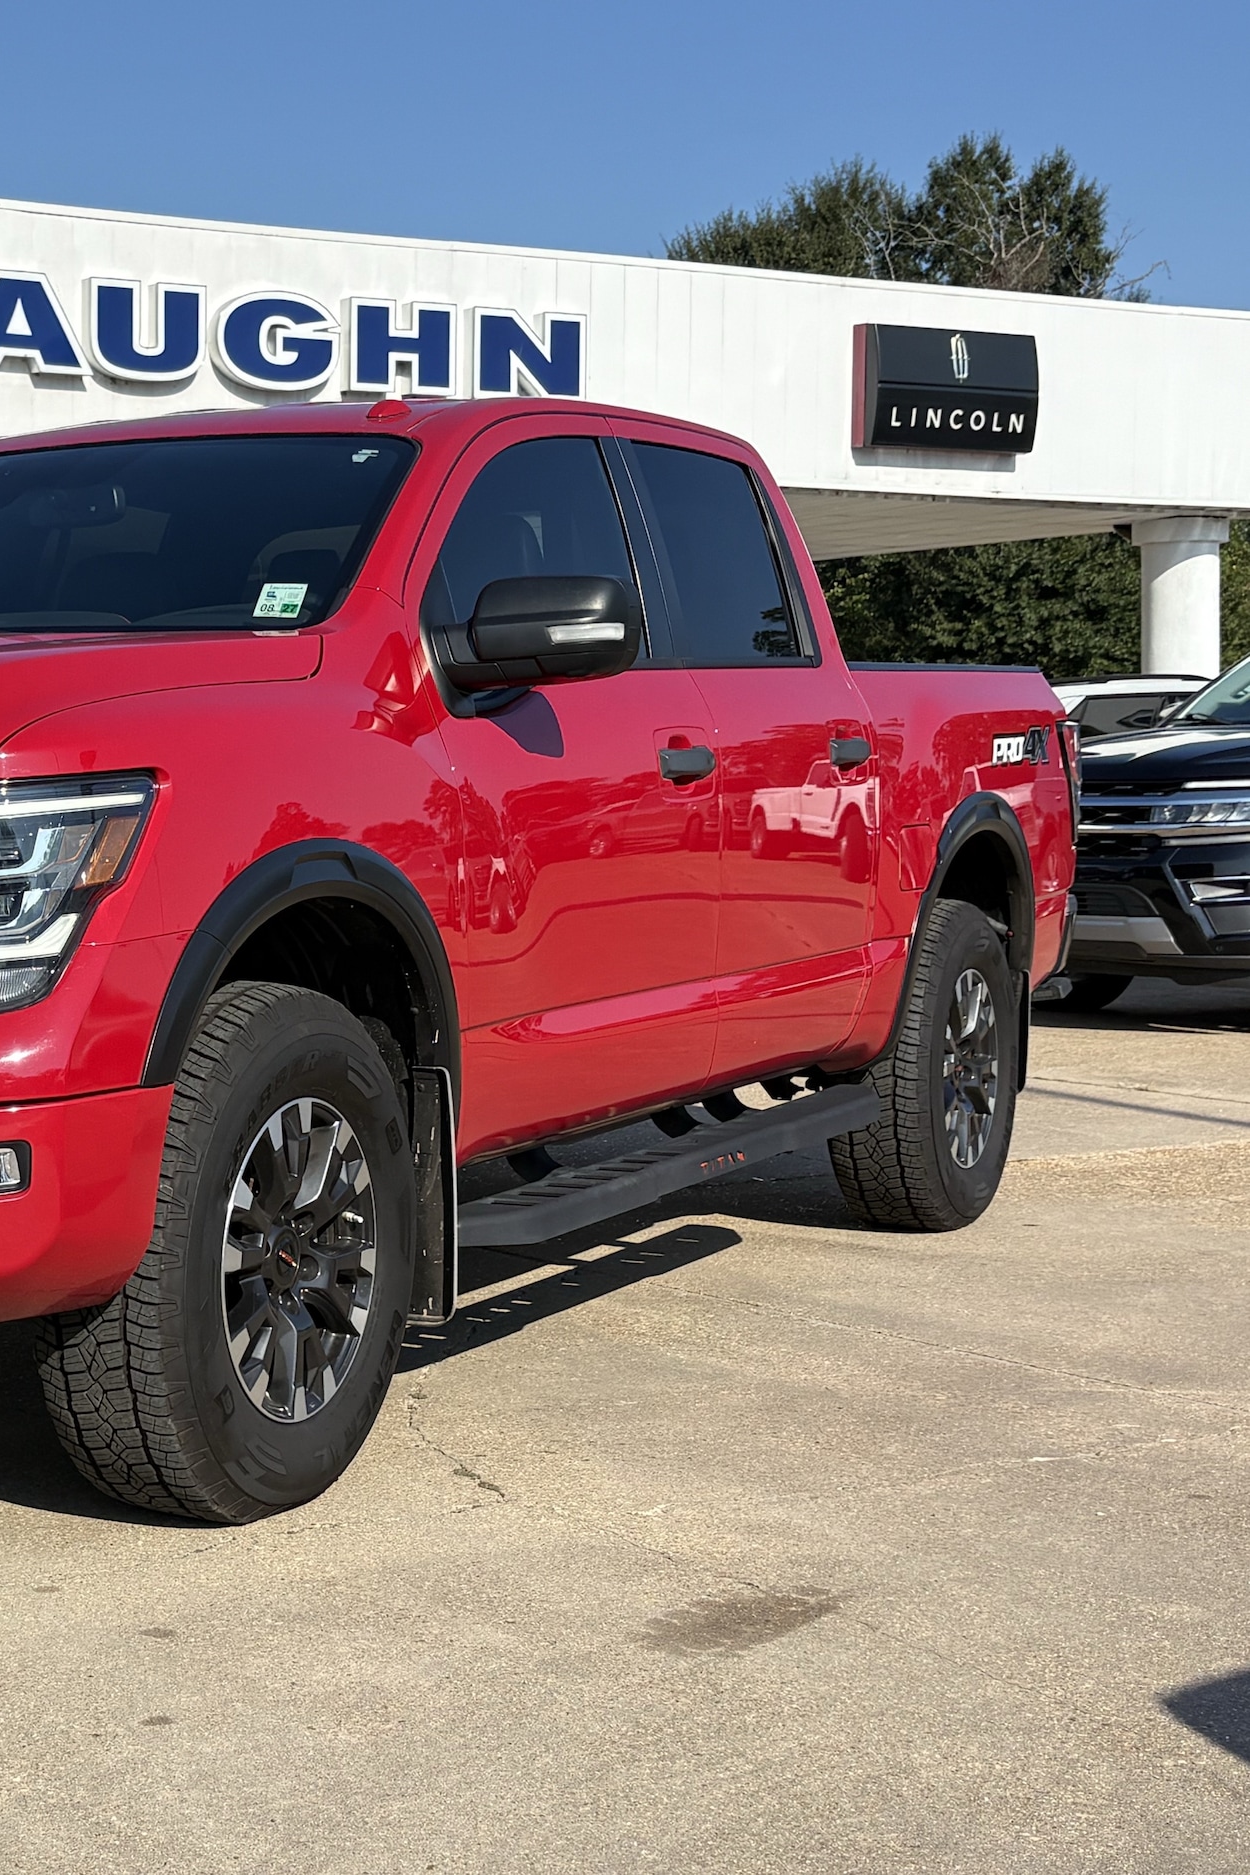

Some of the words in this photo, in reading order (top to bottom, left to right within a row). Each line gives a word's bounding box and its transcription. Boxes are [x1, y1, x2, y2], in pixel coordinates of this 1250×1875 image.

[890, 406, 1025, 433] LINCOLN
[260, 604, 275, 612] 08
[283, 604, 297, 613] 27
